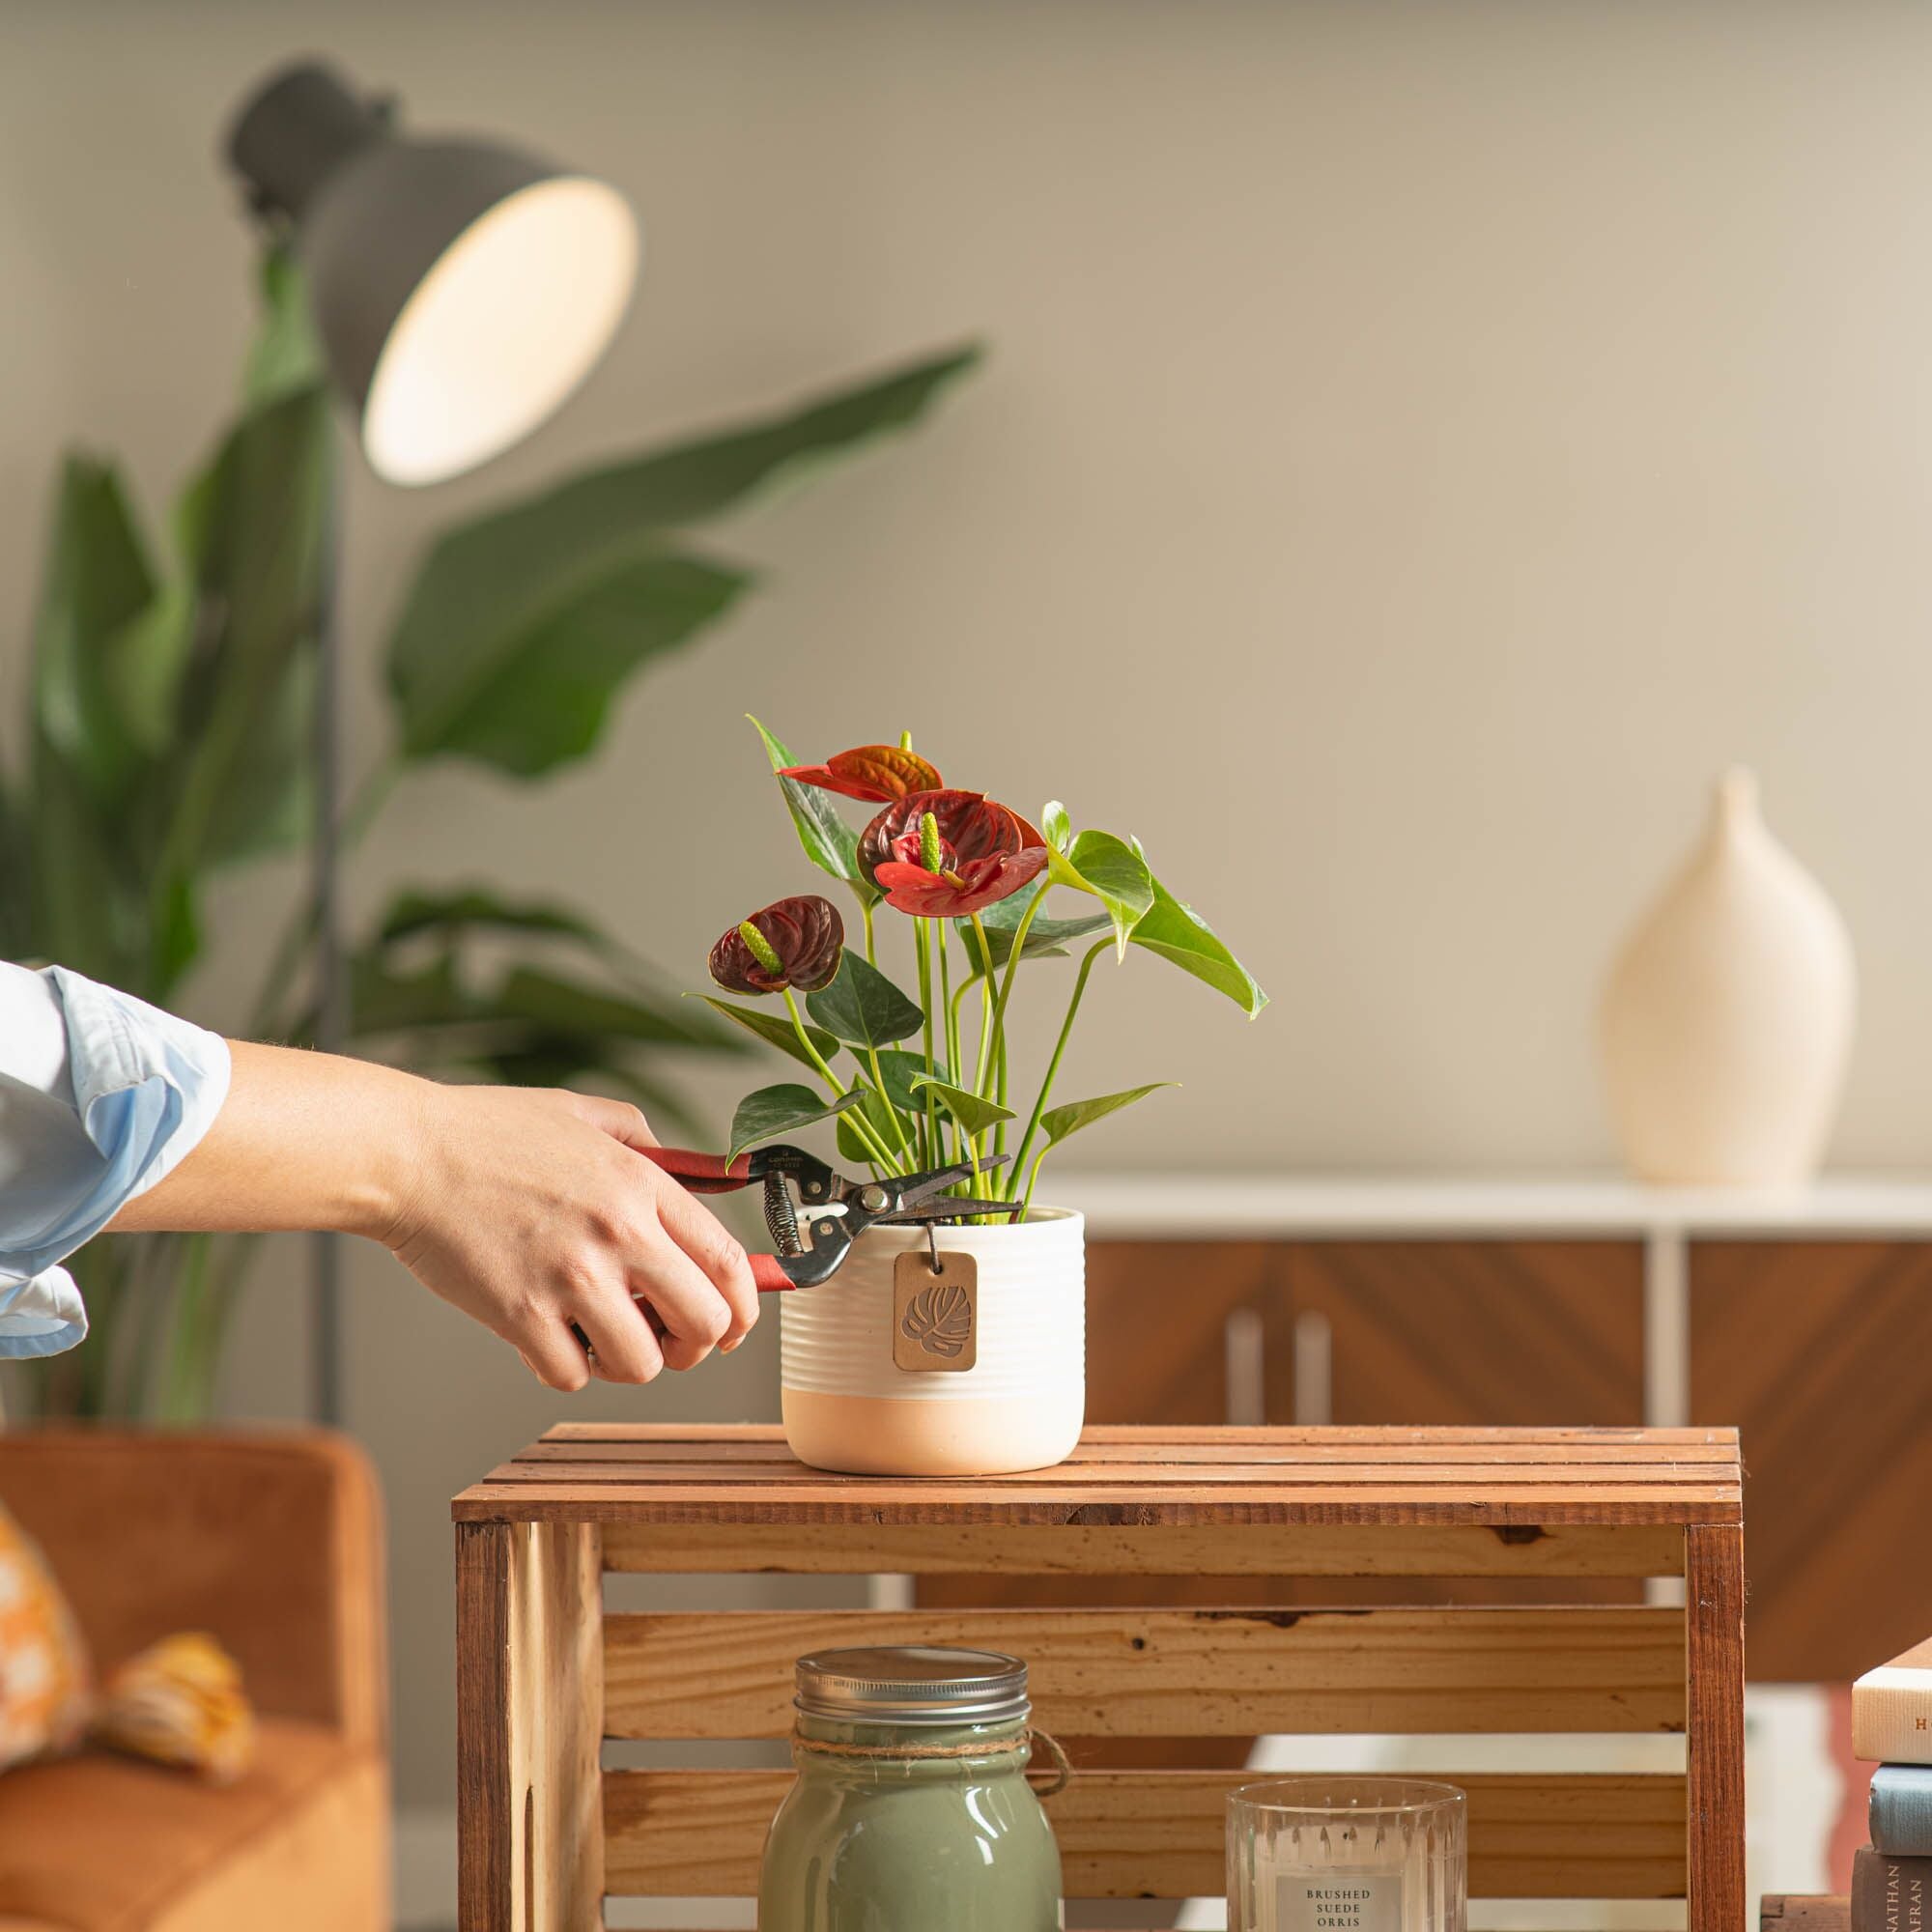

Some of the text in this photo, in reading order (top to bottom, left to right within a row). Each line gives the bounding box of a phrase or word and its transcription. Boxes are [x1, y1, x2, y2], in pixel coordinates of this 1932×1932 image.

[1915, 1719, 1932, 1730] H
[1306, 1889, 1370, 1899] BRUSHED
[1316, 1904, 1360, 1914] SUEDE
[1317, 1918, 1360, 1927] ORRIS
